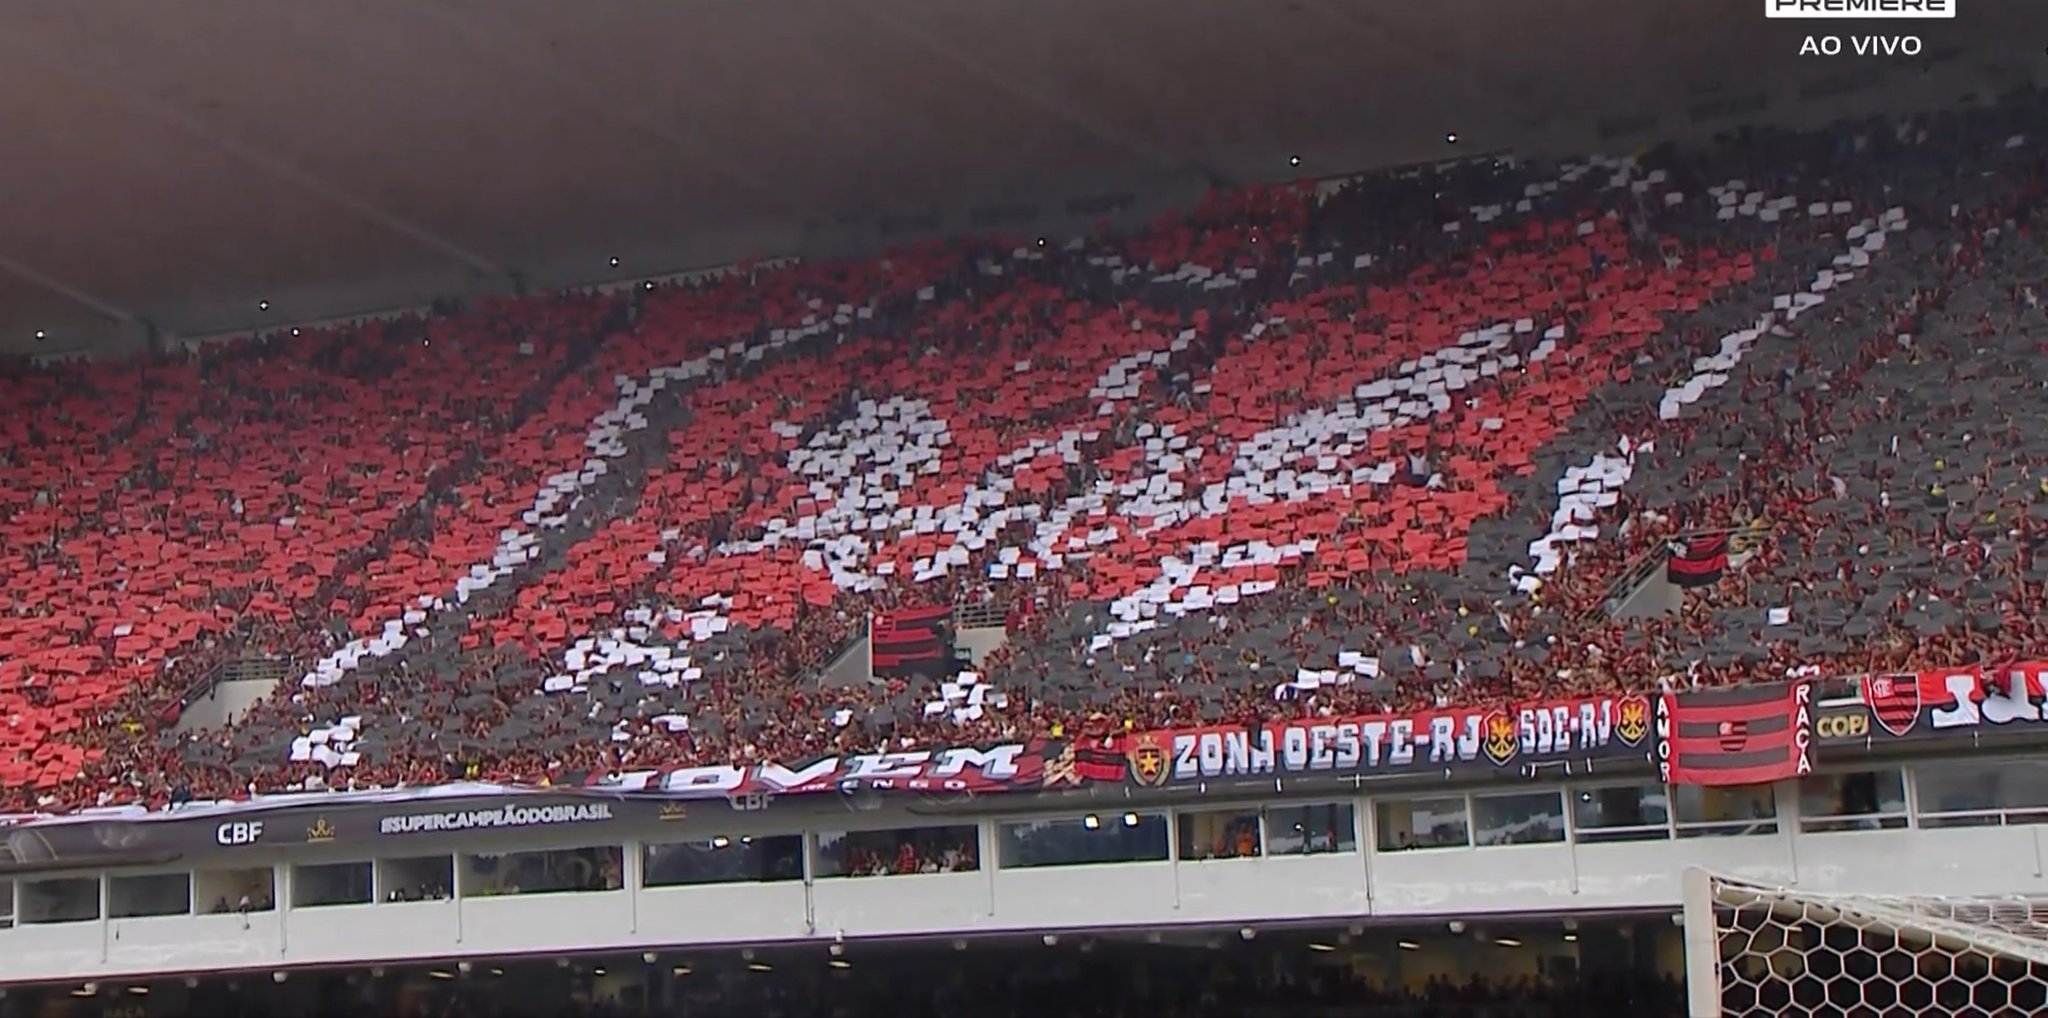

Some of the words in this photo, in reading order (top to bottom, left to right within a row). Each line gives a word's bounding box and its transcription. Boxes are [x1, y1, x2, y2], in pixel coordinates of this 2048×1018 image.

[1174, 730, 1275, 779] ZONA
[1284, 715, 1482, 771] OESTE-RJ
[1657, 697, 1670, 782] AMOR
[217, 822, 265, 844] CBF
[380, 804, 612, 833] #SUPERCAMPEÃODOBRASIL
